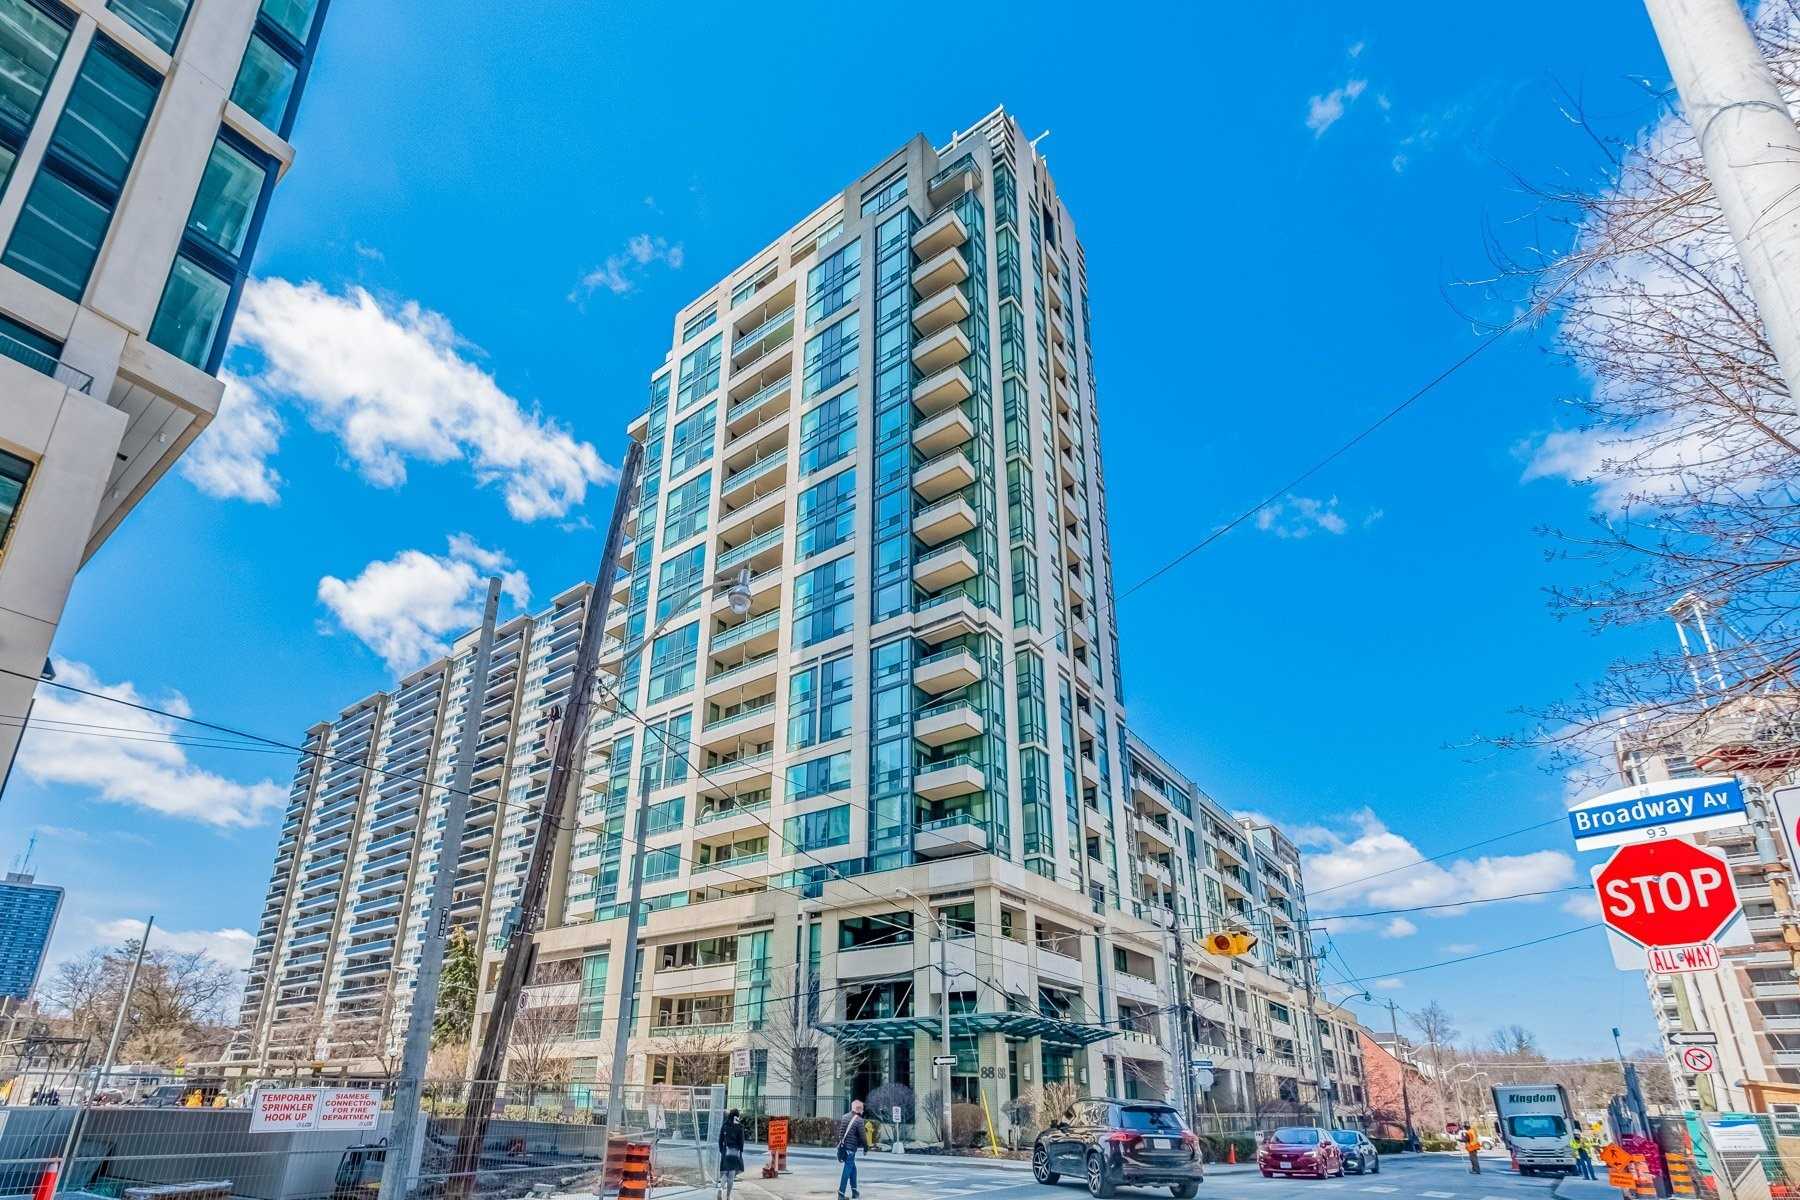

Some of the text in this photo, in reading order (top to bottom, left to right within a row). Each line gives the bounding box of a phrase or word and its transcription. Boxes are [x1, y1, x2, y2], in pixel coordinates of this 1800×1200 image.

[1575, 791, 1728, 831] Broadway Av
[1646, 826, 1669, 839] 93
[1605, 867, 1722, 918] STOP
[1654, 945, 1713, 971] ALL WAY
[981, 1066, 995, 1079] 88
[262, 1093, 318, 1102] TEMPORARY
[1508, 1093, 1556, 1104] Kingdom
[262, 1103, 314, 1112] SPRINKLER
[264, 1112, 308, 1122] HOOK UP
[322, 1113, 375, 1121] DEPARTMENT
